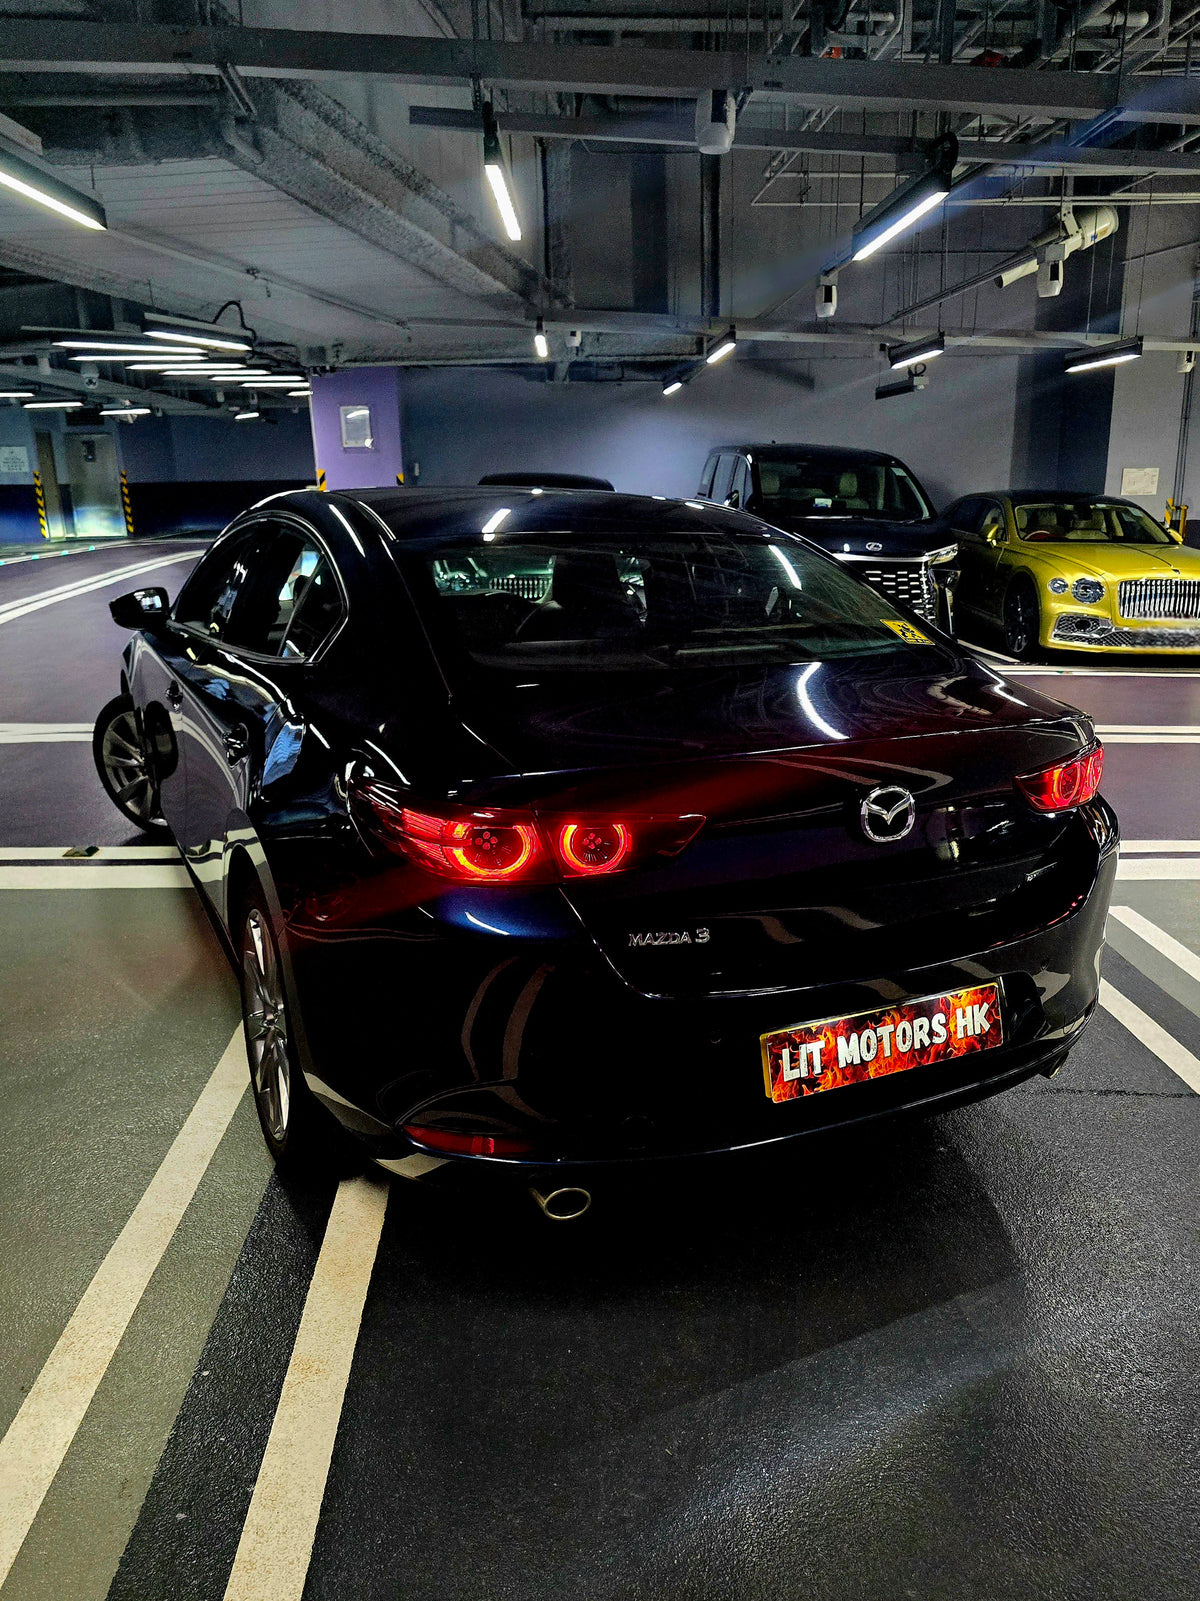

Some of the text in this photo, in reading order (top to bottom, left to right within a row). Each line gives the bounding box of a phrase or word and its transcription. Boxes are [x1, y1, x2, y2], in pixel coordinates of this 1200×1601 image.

[782, 1002, 991, 1081] LIT MOTORS HK
